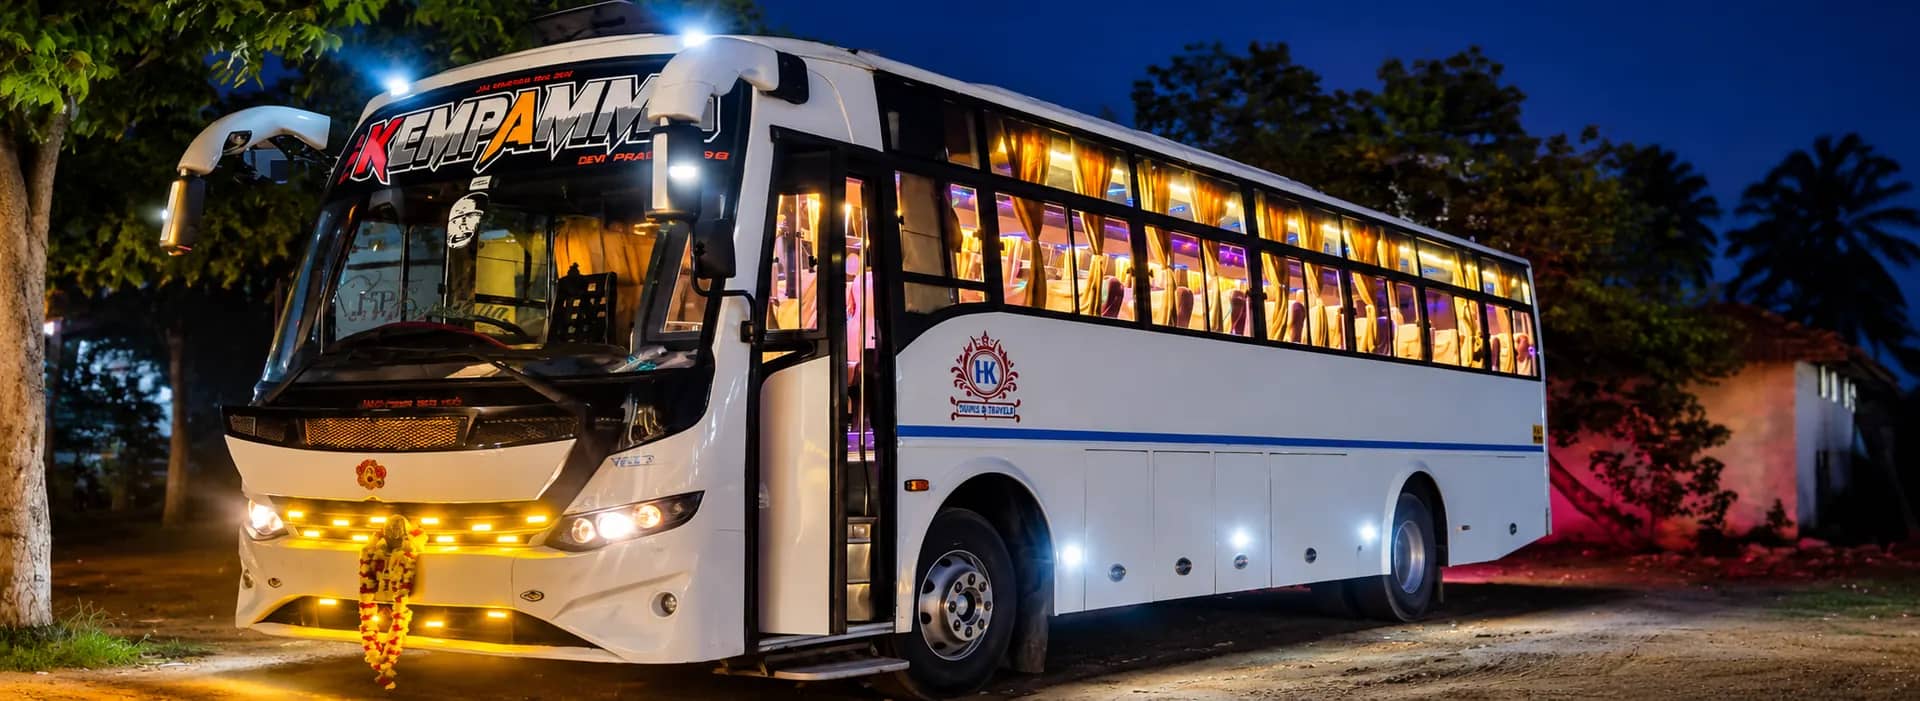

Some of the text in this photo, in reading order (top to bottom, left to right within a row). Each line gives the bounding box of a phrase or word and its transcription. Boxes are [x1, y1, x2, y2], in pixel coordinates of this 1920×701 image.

[350, 73, 721, 186] KEMPAMM
[577, 153, 607, 165] DEVI
[975, 359, 997, 384] HK
